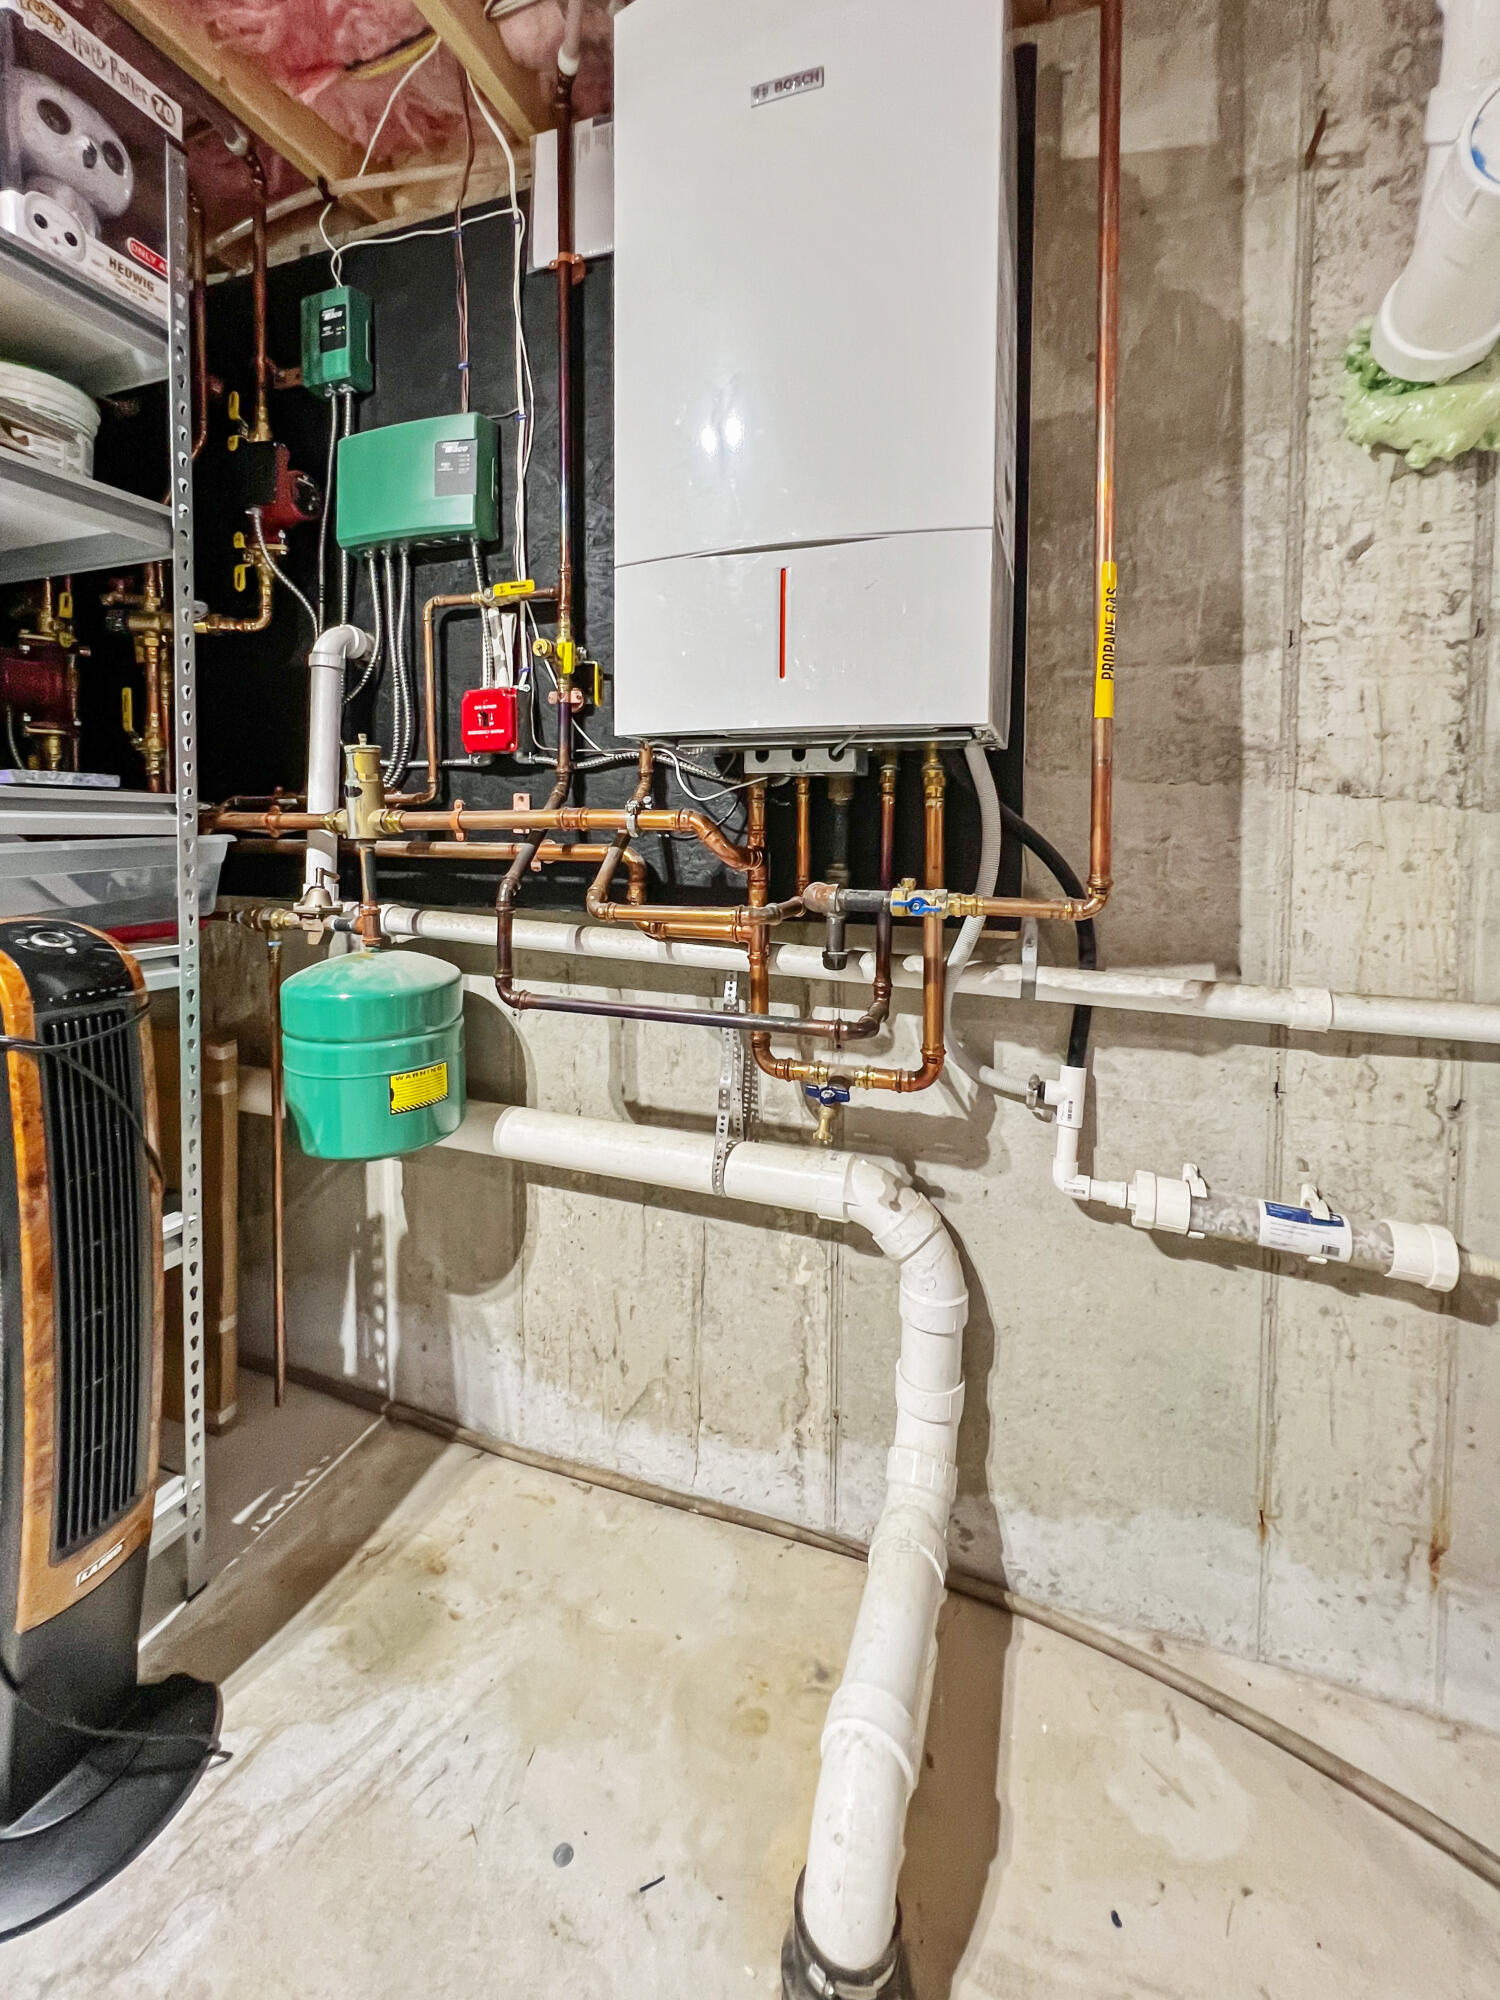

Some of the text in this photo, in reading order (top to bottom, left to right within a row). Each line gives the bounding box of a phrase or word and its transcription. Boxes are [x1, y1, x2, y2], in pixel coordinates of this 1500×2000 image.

[774, 68, 820, 93] BOSCH
[132, 242, 156, 266] ONLY
[108, 256, 155, 292] HEDWIG
[1101, 587, 1117, 681] PROPANE GAS
